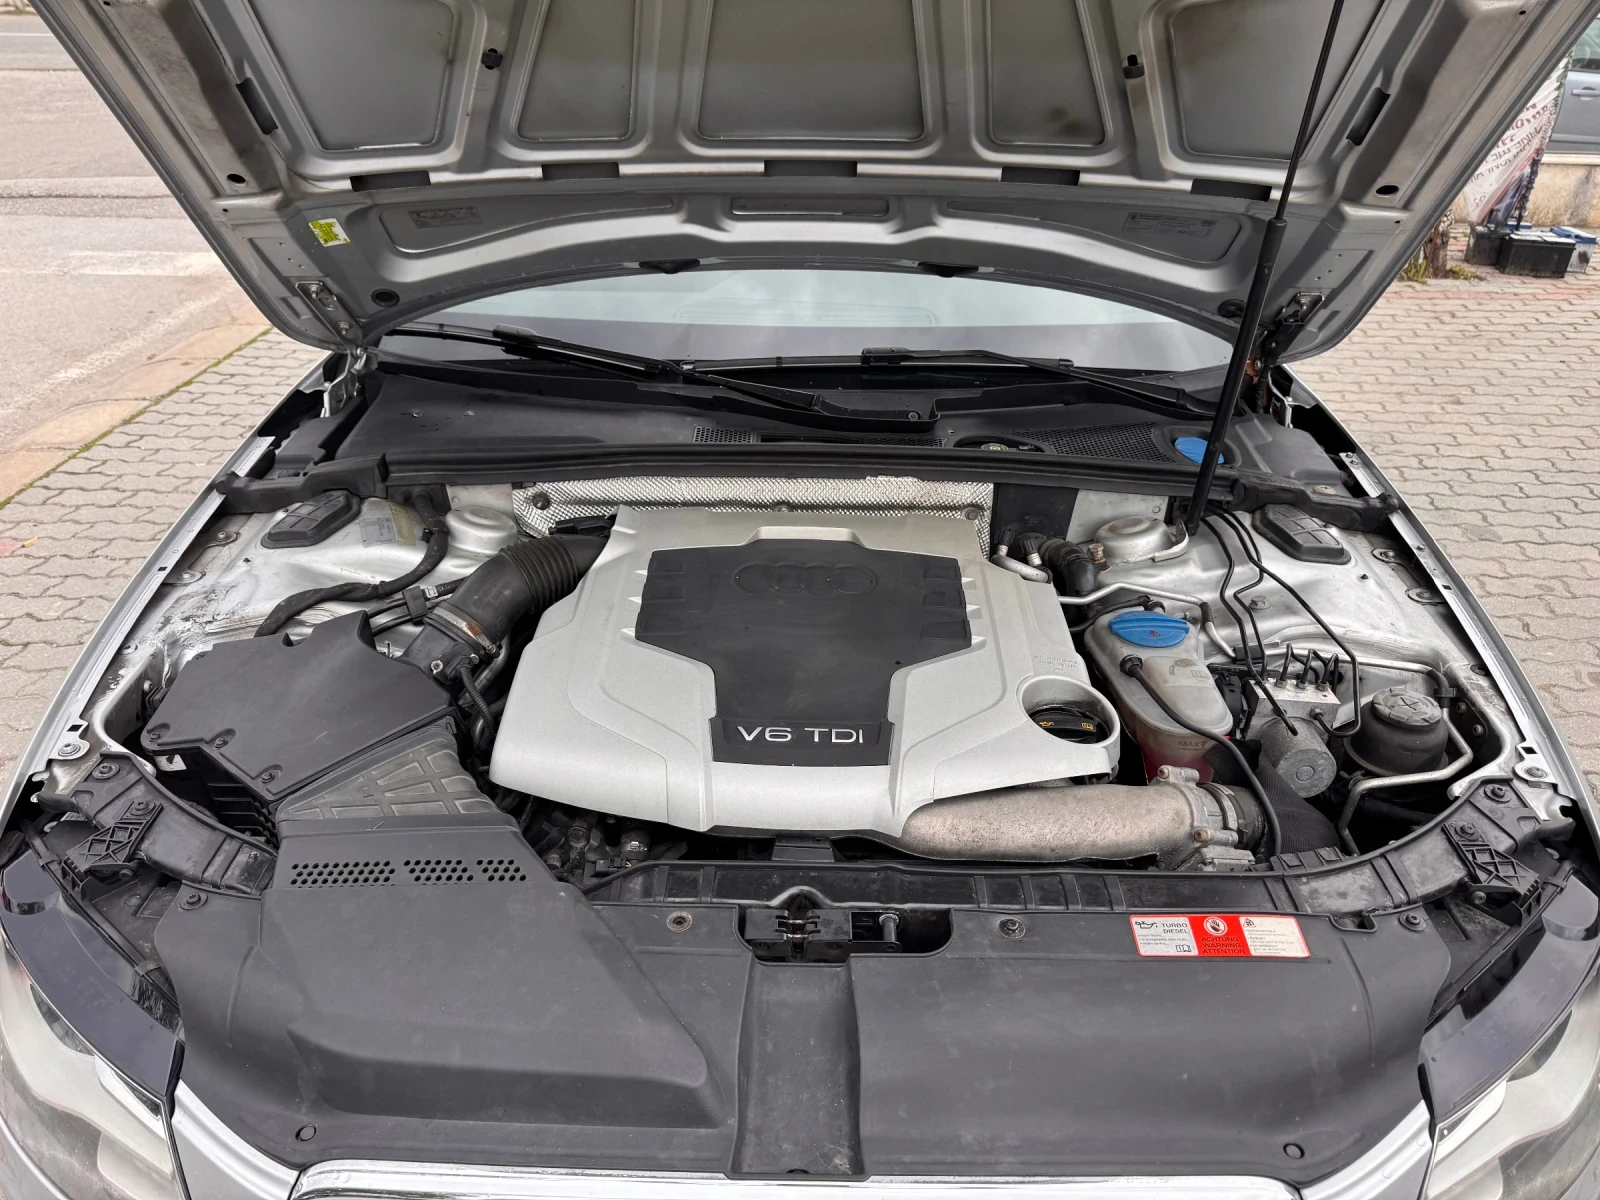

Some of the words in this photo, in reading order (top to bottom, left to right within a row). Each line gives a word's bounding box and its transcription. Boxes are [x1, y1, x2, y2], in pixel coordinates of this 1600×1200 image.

[737, 726, 792, 742] V6
[804, 727, 863, 743] TDI
[1177, 740, 1201, 748] MAX
